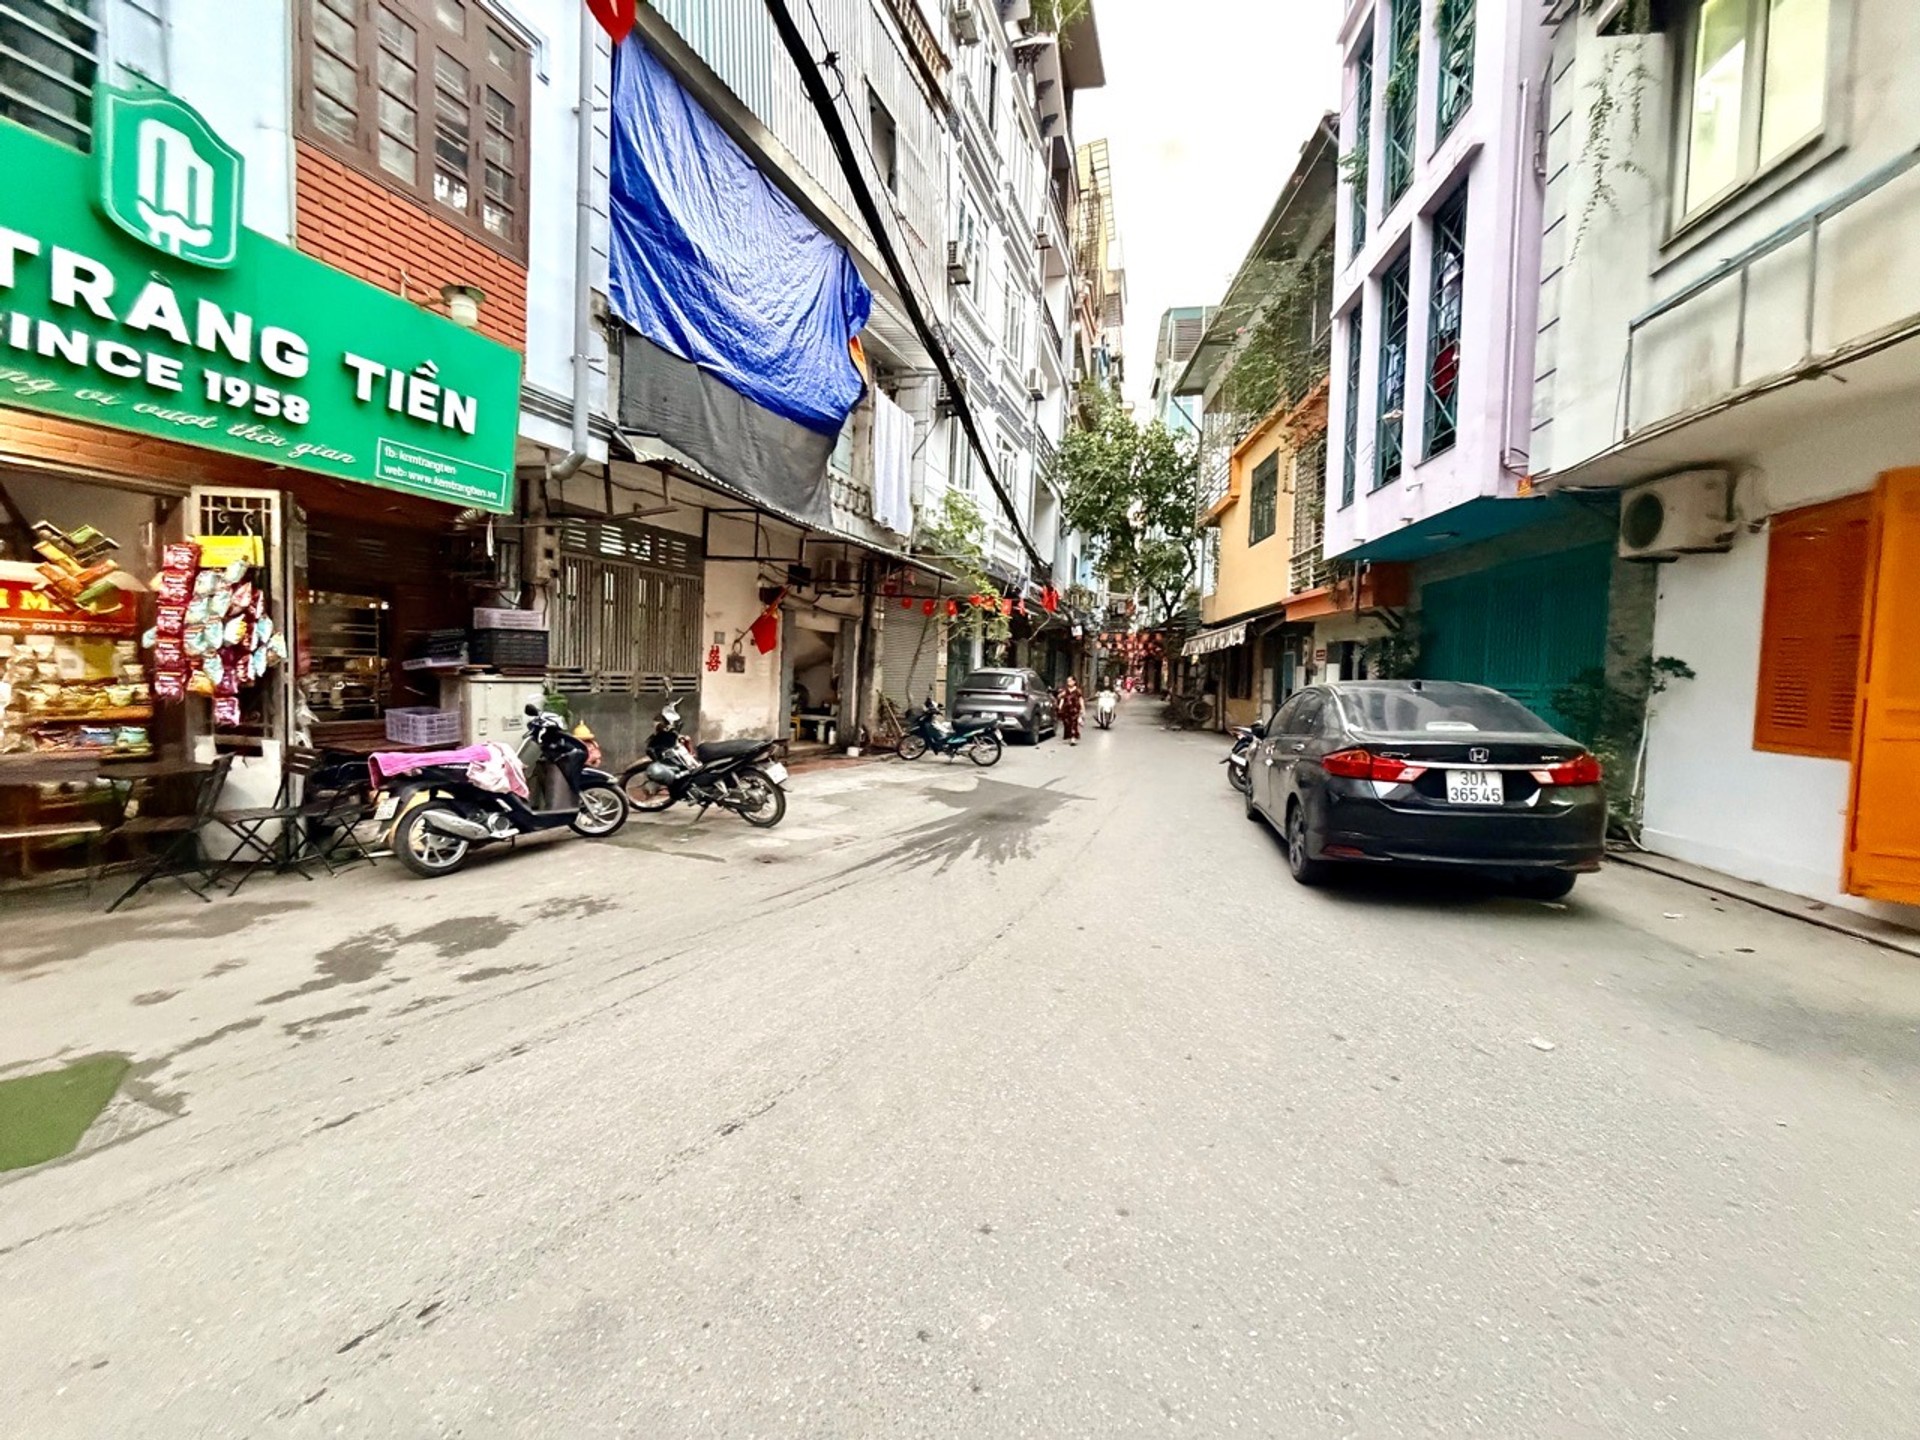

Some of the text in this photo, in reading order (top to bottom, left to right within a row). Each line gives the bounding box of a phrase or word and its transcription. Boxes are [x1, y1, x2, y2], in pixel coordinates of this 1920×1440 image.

[0, 310, 310, 425] INCE 1958
[344, 351, 478, 435] TIỀN
[287, 443, 357, 464] gian
[1460, 770, 1488, 786] 30A
[1450, 787, 1502, 803] 365.45
